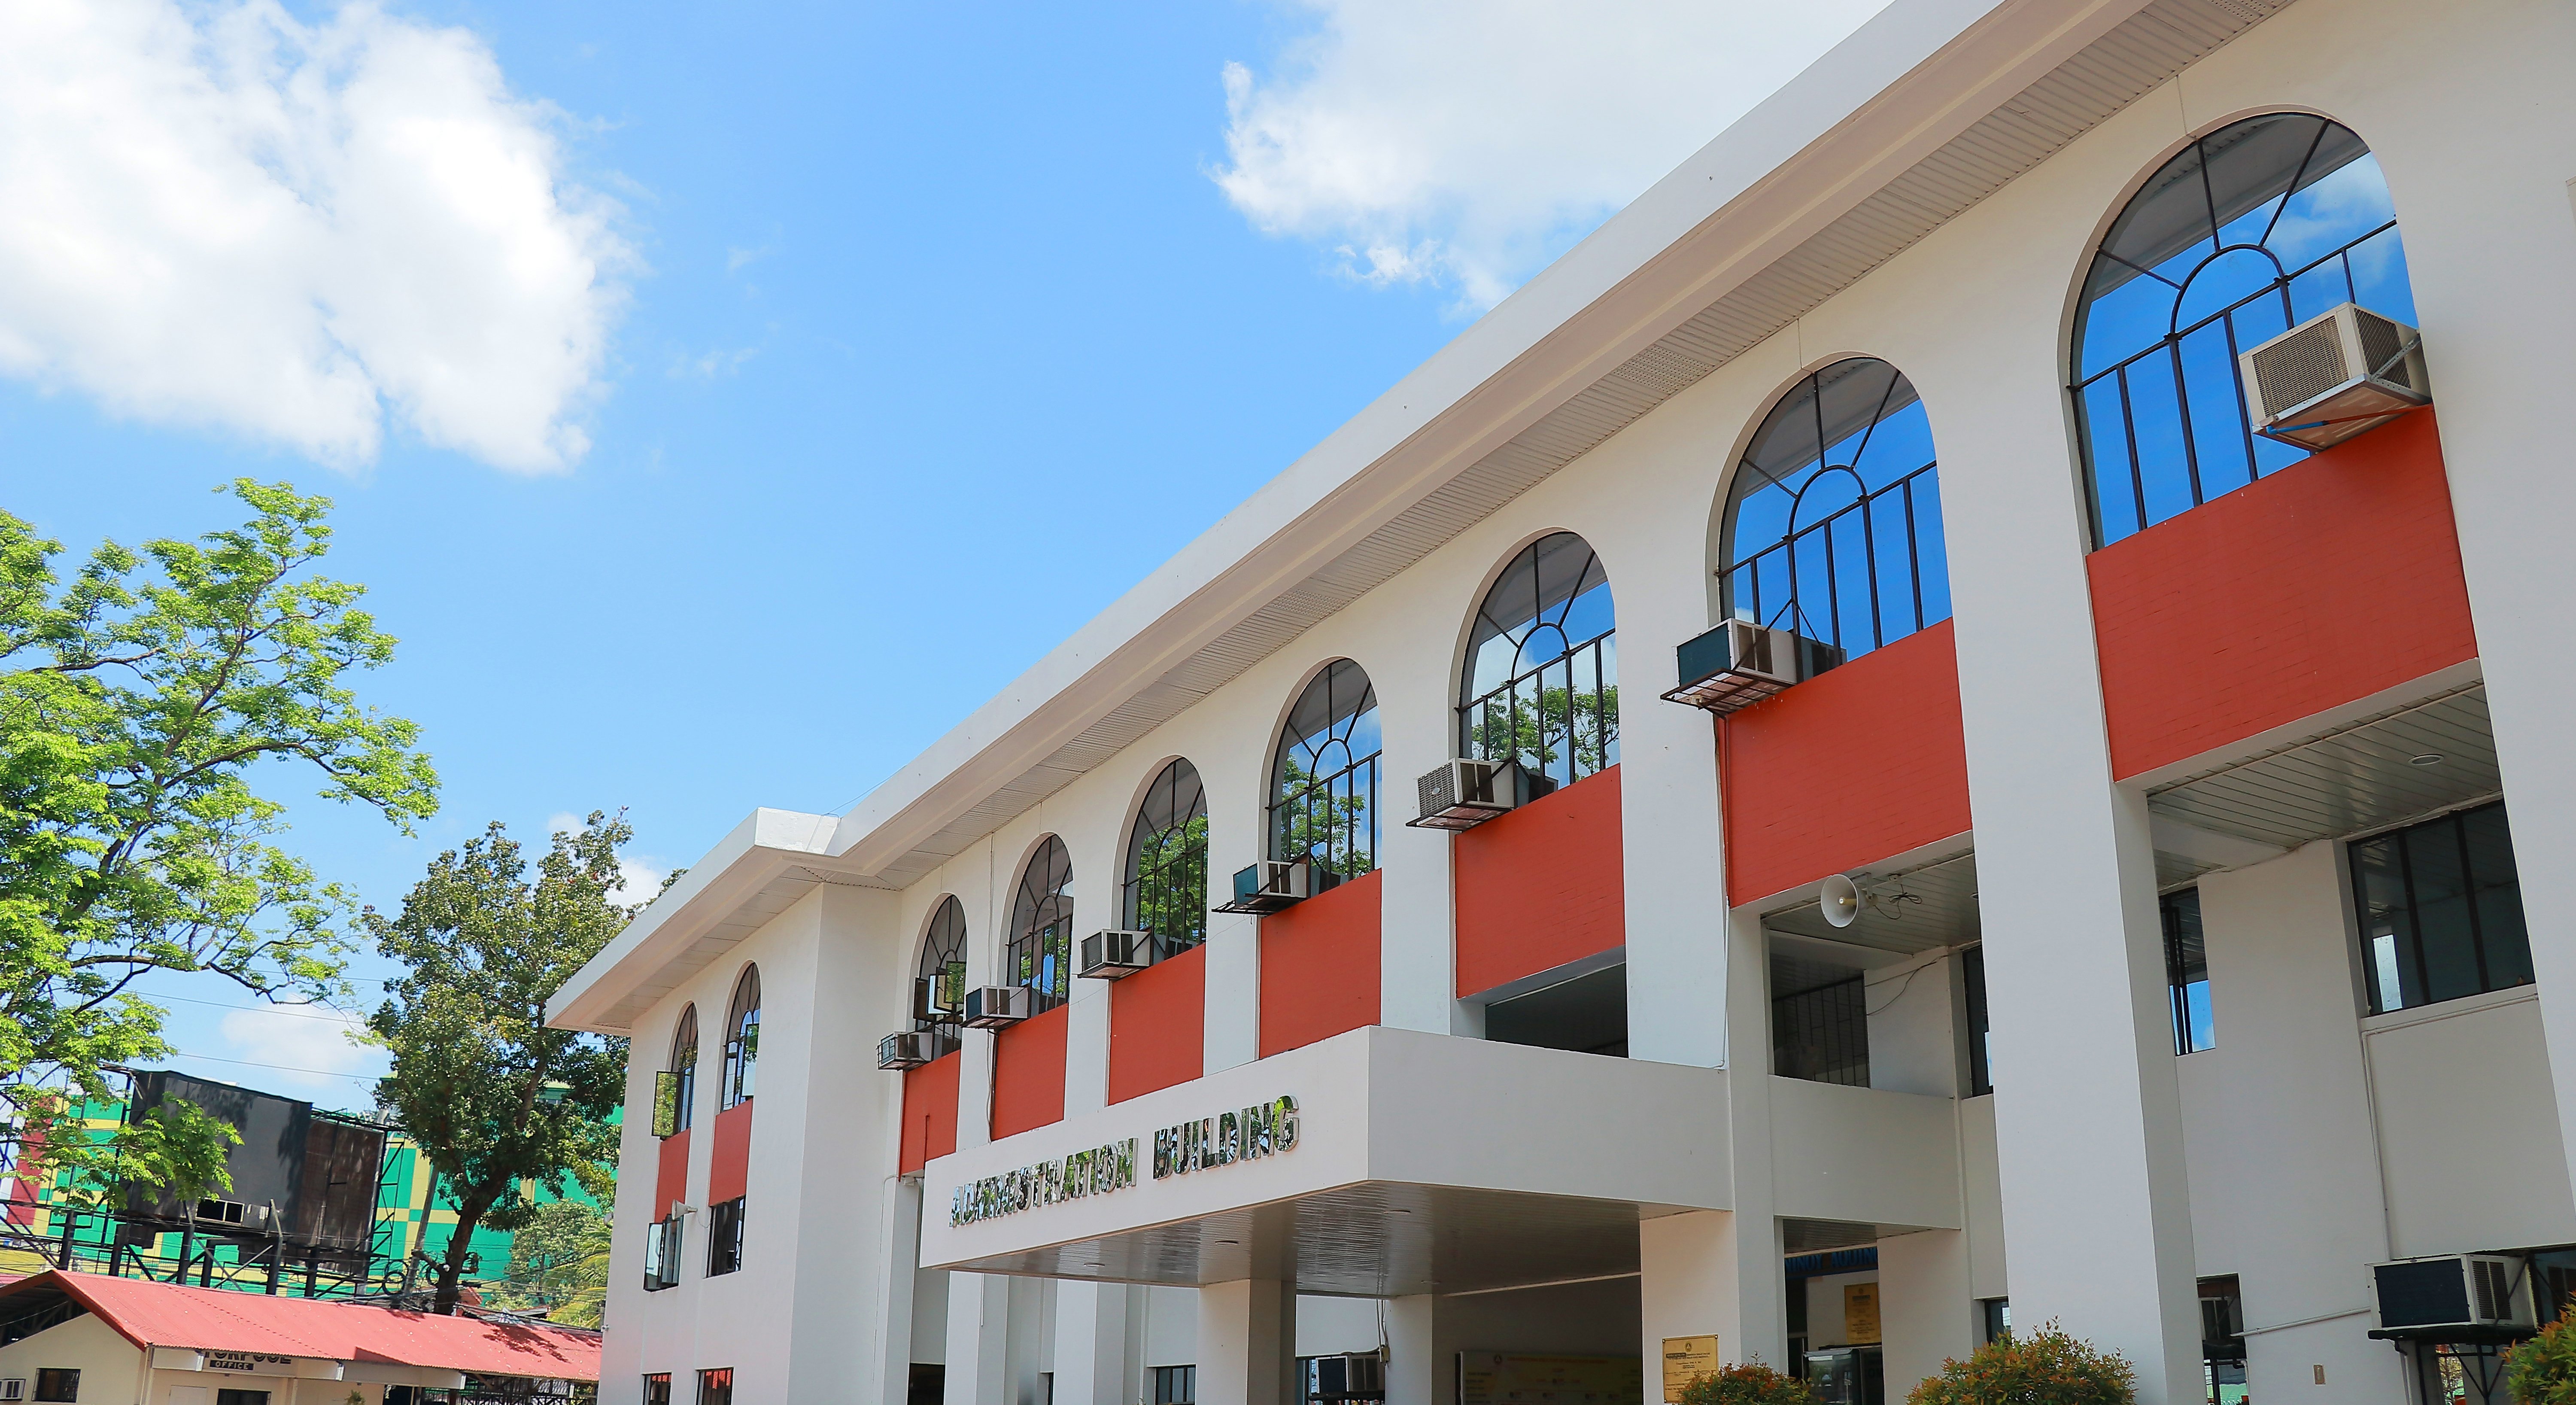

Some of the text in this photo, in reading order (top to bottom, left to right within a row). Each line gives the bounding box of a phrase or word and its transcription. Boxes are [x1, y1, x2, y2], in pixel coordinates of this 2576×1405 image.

[949, 1095, 1300, 1228] ADMINISTRATION BUILDING
[216, 1361, 249, 1370] OFFICE
